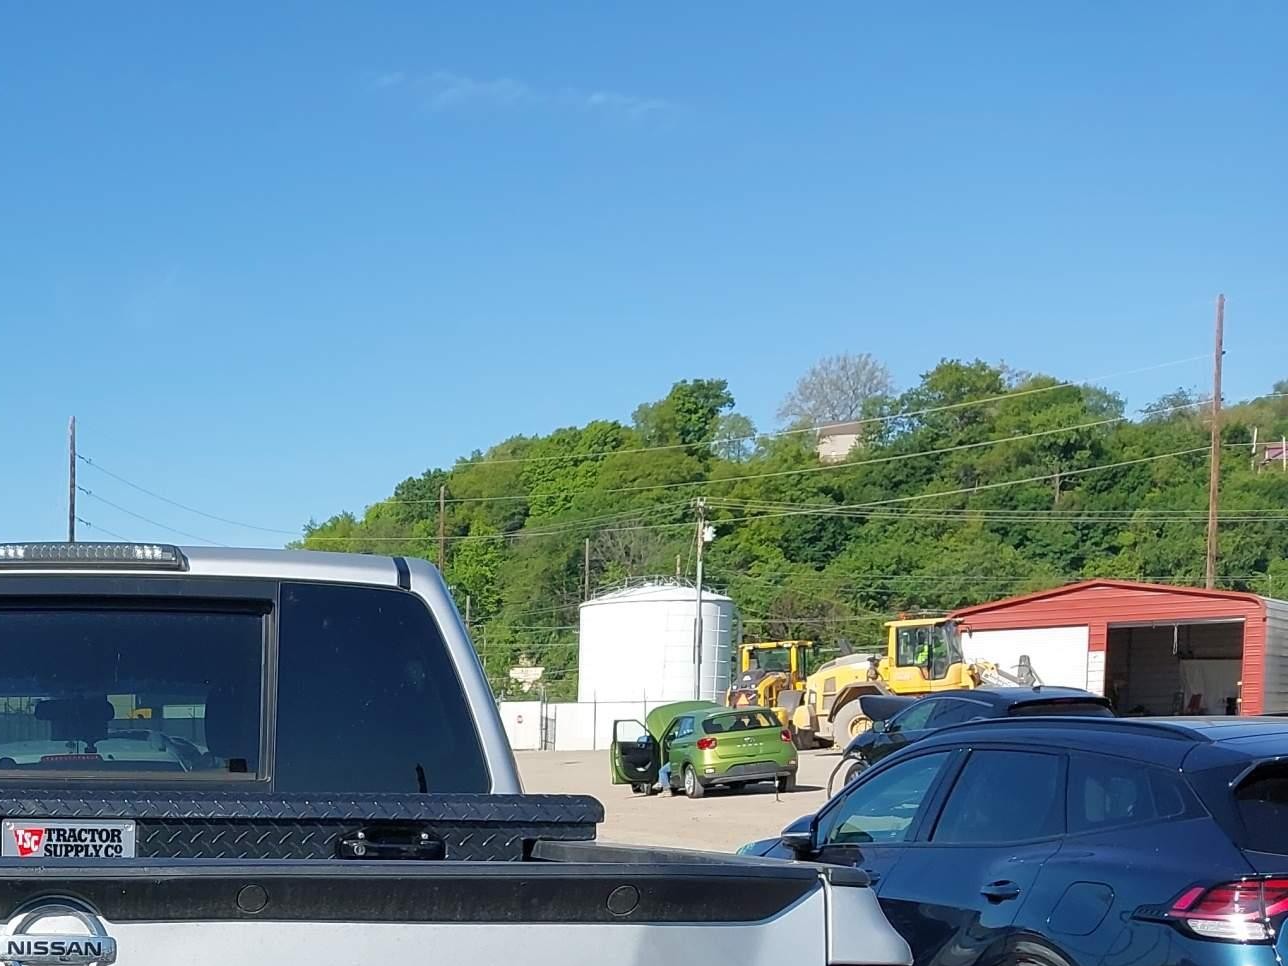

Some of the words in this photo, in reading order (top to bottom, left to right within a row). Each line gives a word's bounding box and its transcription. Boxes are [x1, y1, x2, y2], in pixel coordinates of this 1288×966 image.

[16, 829, 40, 851] TSC
[44, 828, 123, 844] TRACTOR
[43, 844, 103, 857] SUPPLY
[7, 940, 102, 957] NISSAN
